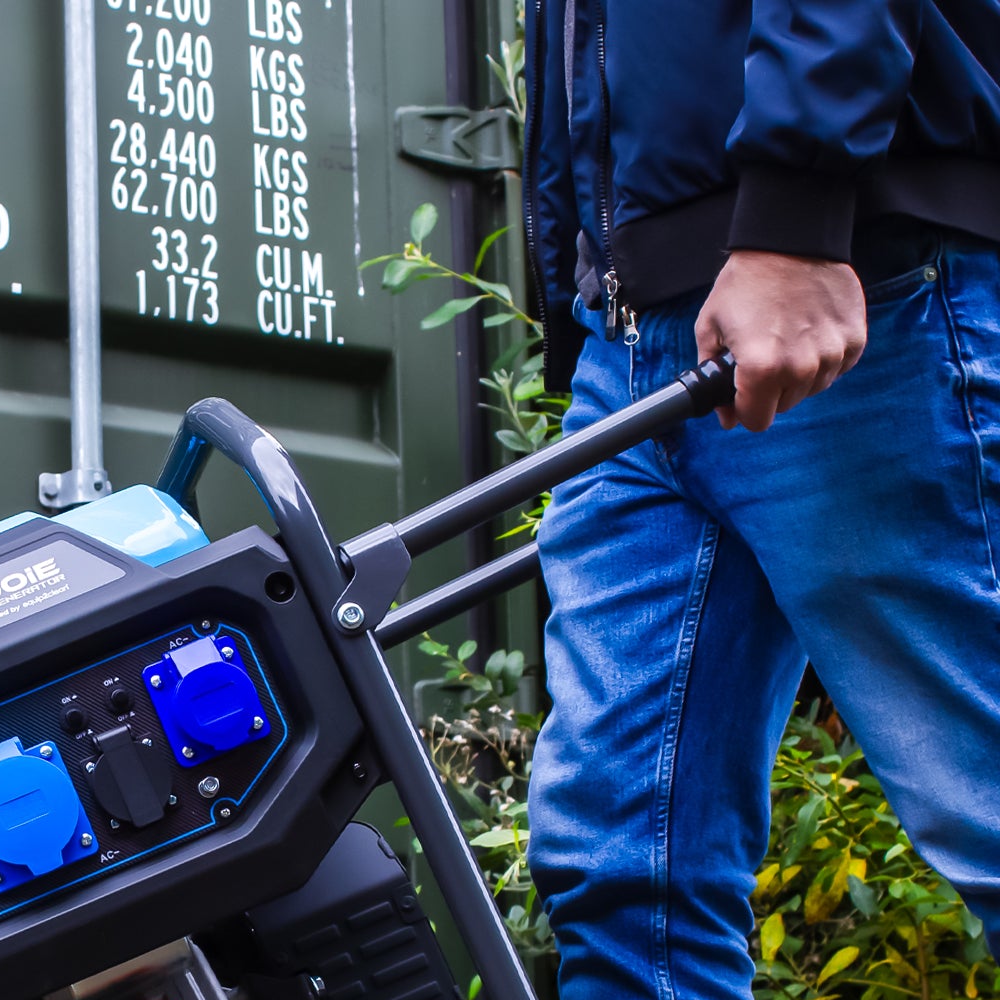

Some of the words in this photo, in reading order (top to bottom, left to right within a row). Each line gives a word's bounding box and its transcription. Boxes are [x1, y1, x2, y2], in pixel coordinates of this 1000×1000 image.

[248, 0, 303, 45] LBS
[250, 45, 306, 97] KGS
[252, 90, 308, 142] LBS
[254, 143, 309, 195] KGS
[255, 189, 310, 240] LBS
[152, 226, 218, 280] 33.2
[256, 244, 334, 298] CU.M.
[136, 270, 220, 325] 1,173
[257, 290, 345, 345] CU.FT.
[10, 604, 21, 614] by
